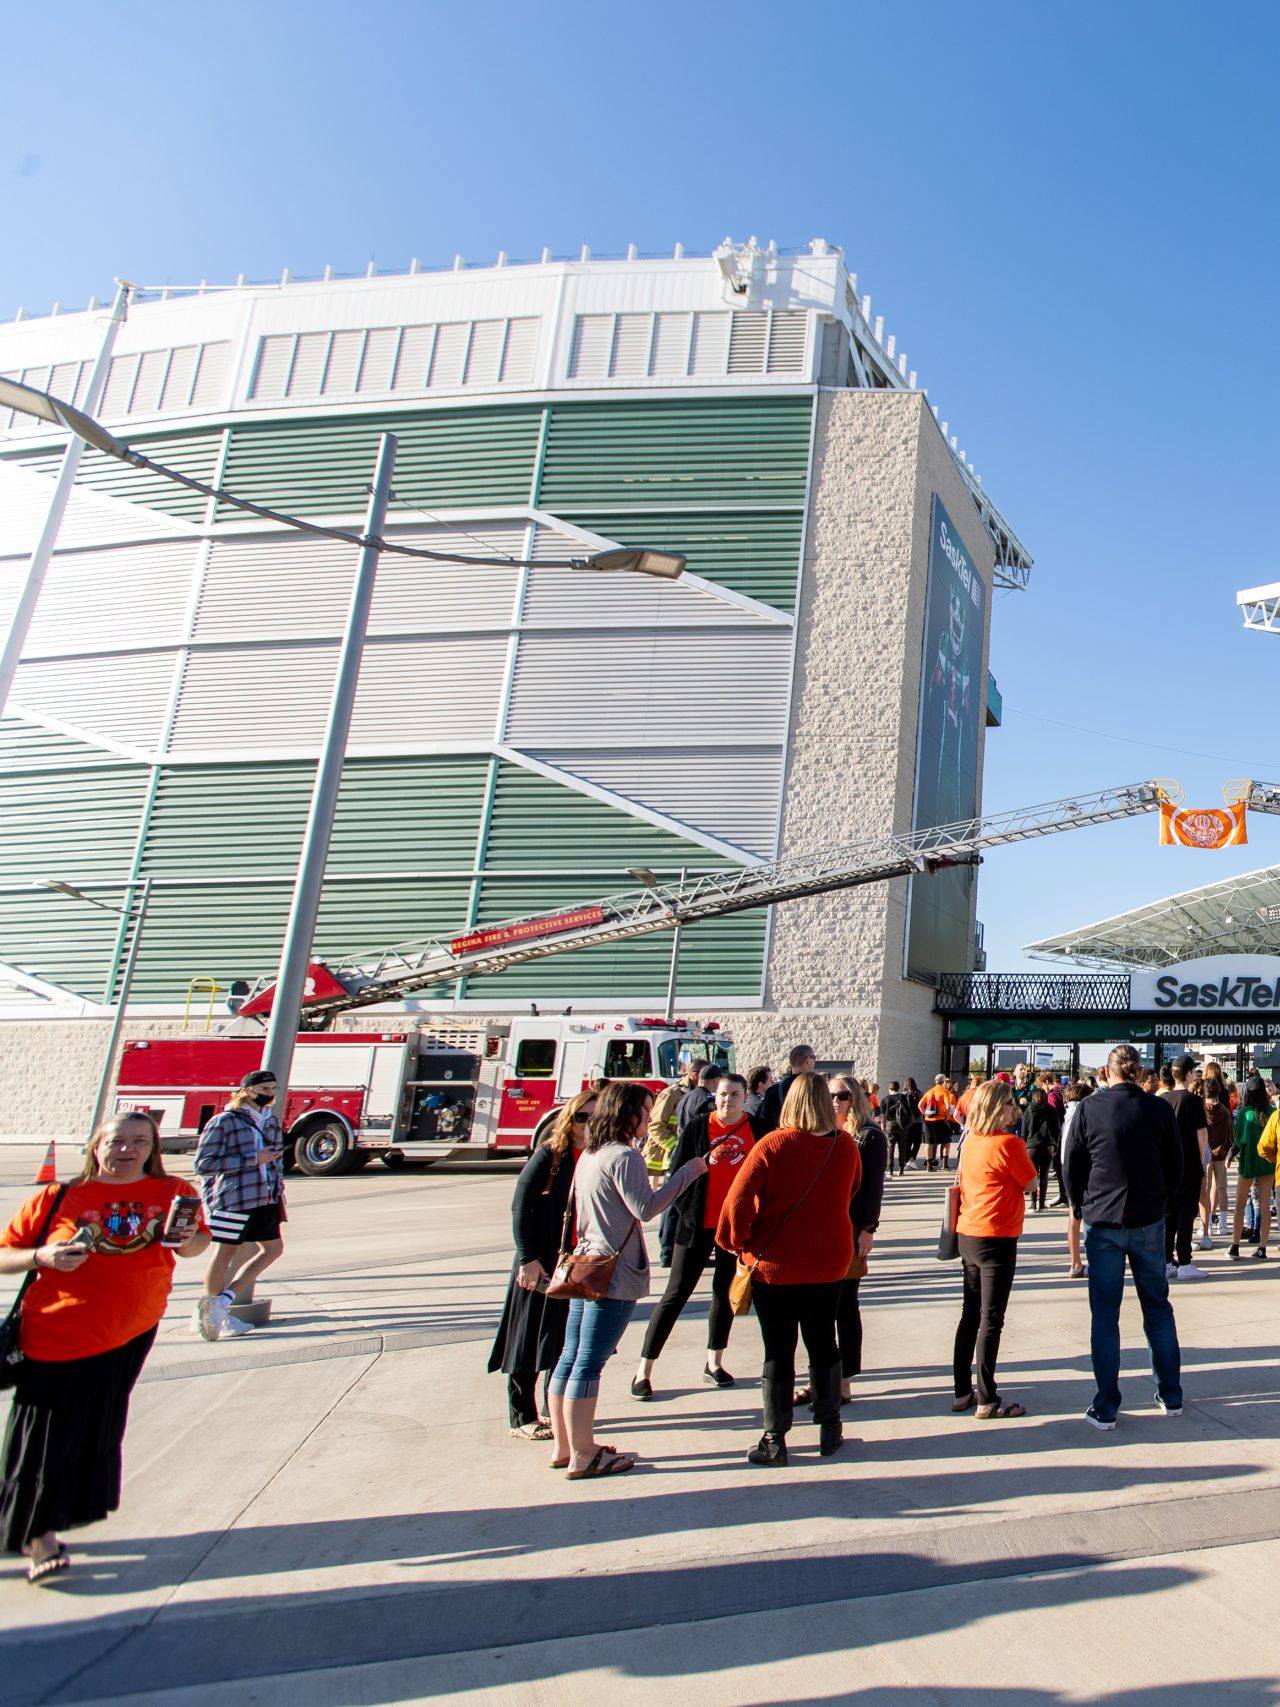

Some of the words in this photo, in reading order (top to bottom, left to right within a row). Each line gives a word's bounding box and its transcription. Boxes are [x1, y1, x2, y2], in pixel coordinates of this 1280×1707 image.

[939, 520, 972, 593] SaskTel
[452, 938, 482, 951] REGINA
[484, 933, 501, 943] FIRE
[513, 919, 563, 937] PROTECTIVE
[564, 910, 602, 926] SERVICES
[1001, 993, 1043, 1010] Gate
[1049, 994, 1060, 1010] 3
[1155, 1024, 1197, 1037] PROUD
[1200, 1024, 1264, 1037] FOUNDING
